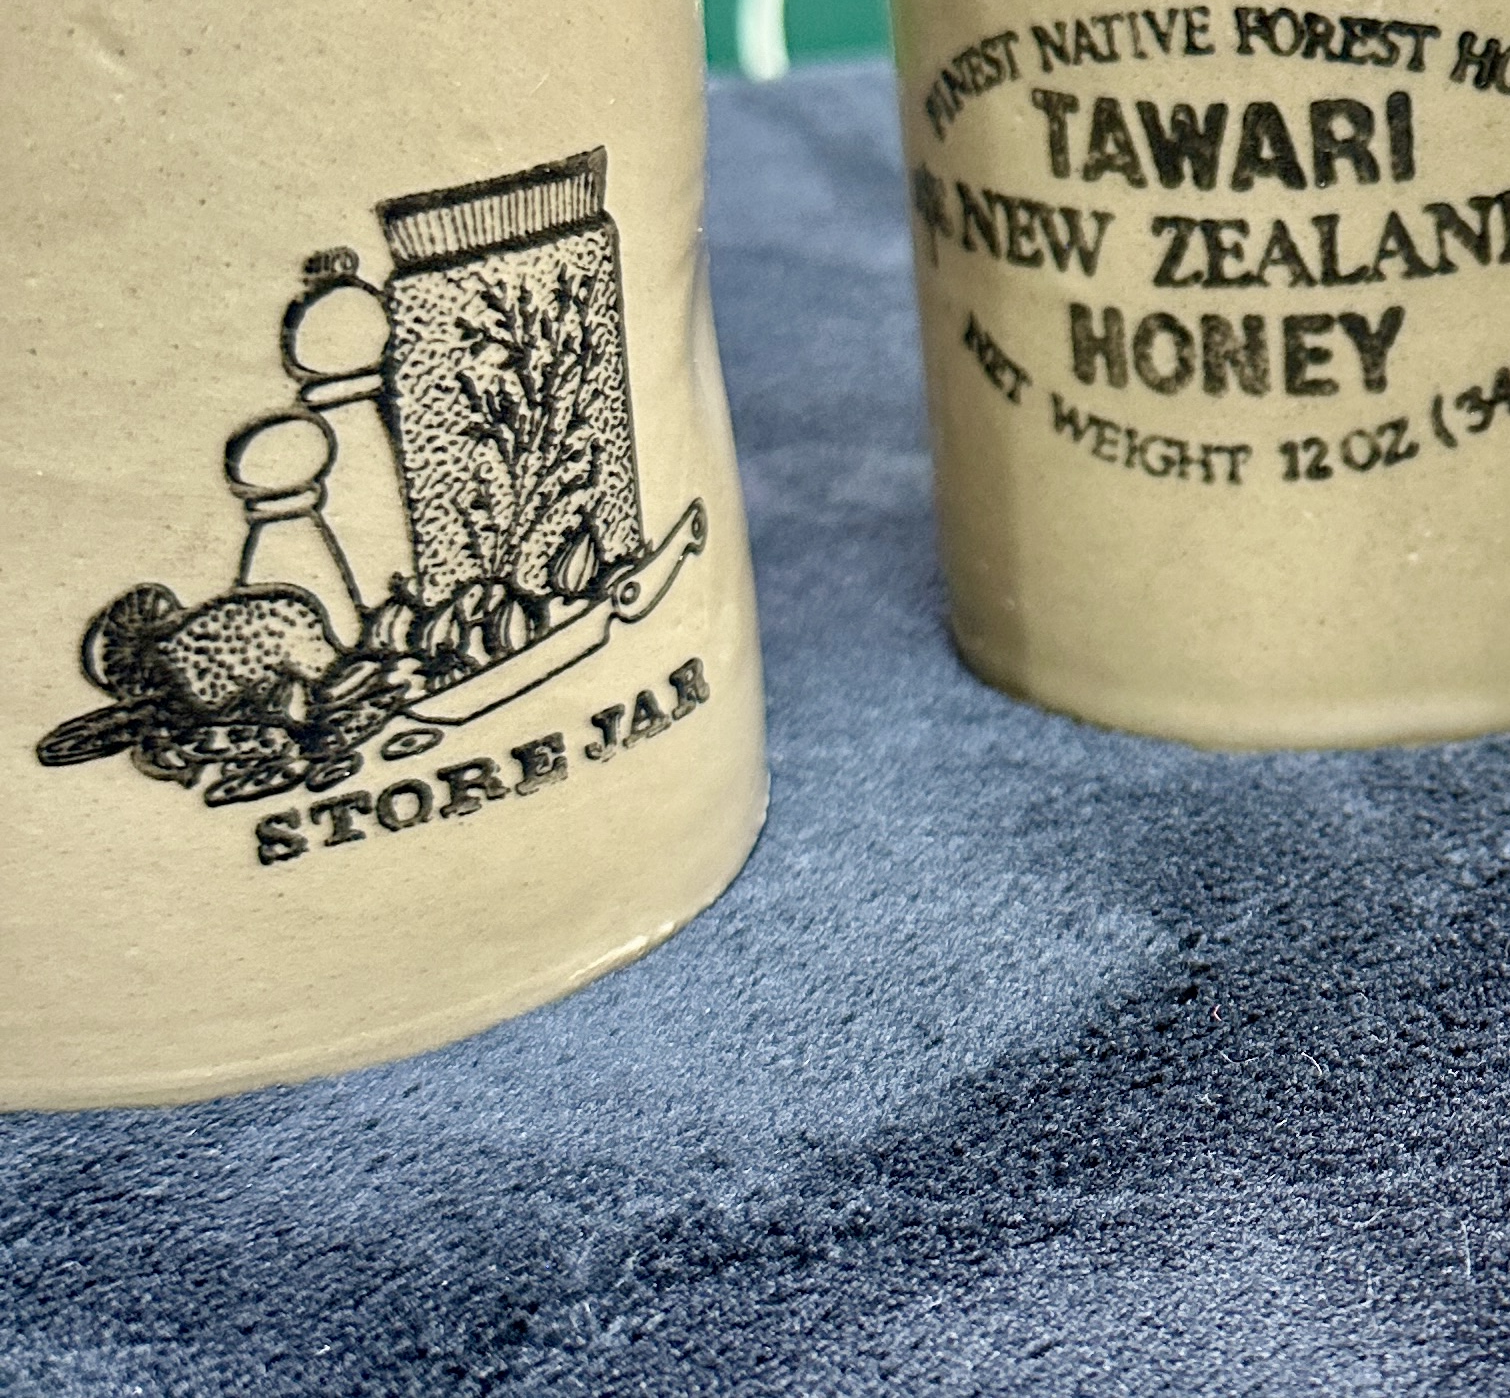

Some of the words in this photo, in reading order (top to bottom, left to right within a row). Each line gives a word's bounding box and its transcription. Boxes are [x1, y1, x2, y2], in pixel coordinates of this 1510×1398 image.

[1030, 5, 1216, 73] NATIVE
[1235, 6, 1439, 72] FOREST
[1030, 87, 1417, 192] TAWARI
[956, 181, 1115, 278] NEW
[964, 309, 1033, 406] NET
[1049, 394, 1253, 485] WEIGHT
[1068, 302, 1406, 397] HONEY
[255, 731, 570, 867] STORE
[585, 657, 712, 762] JAR
